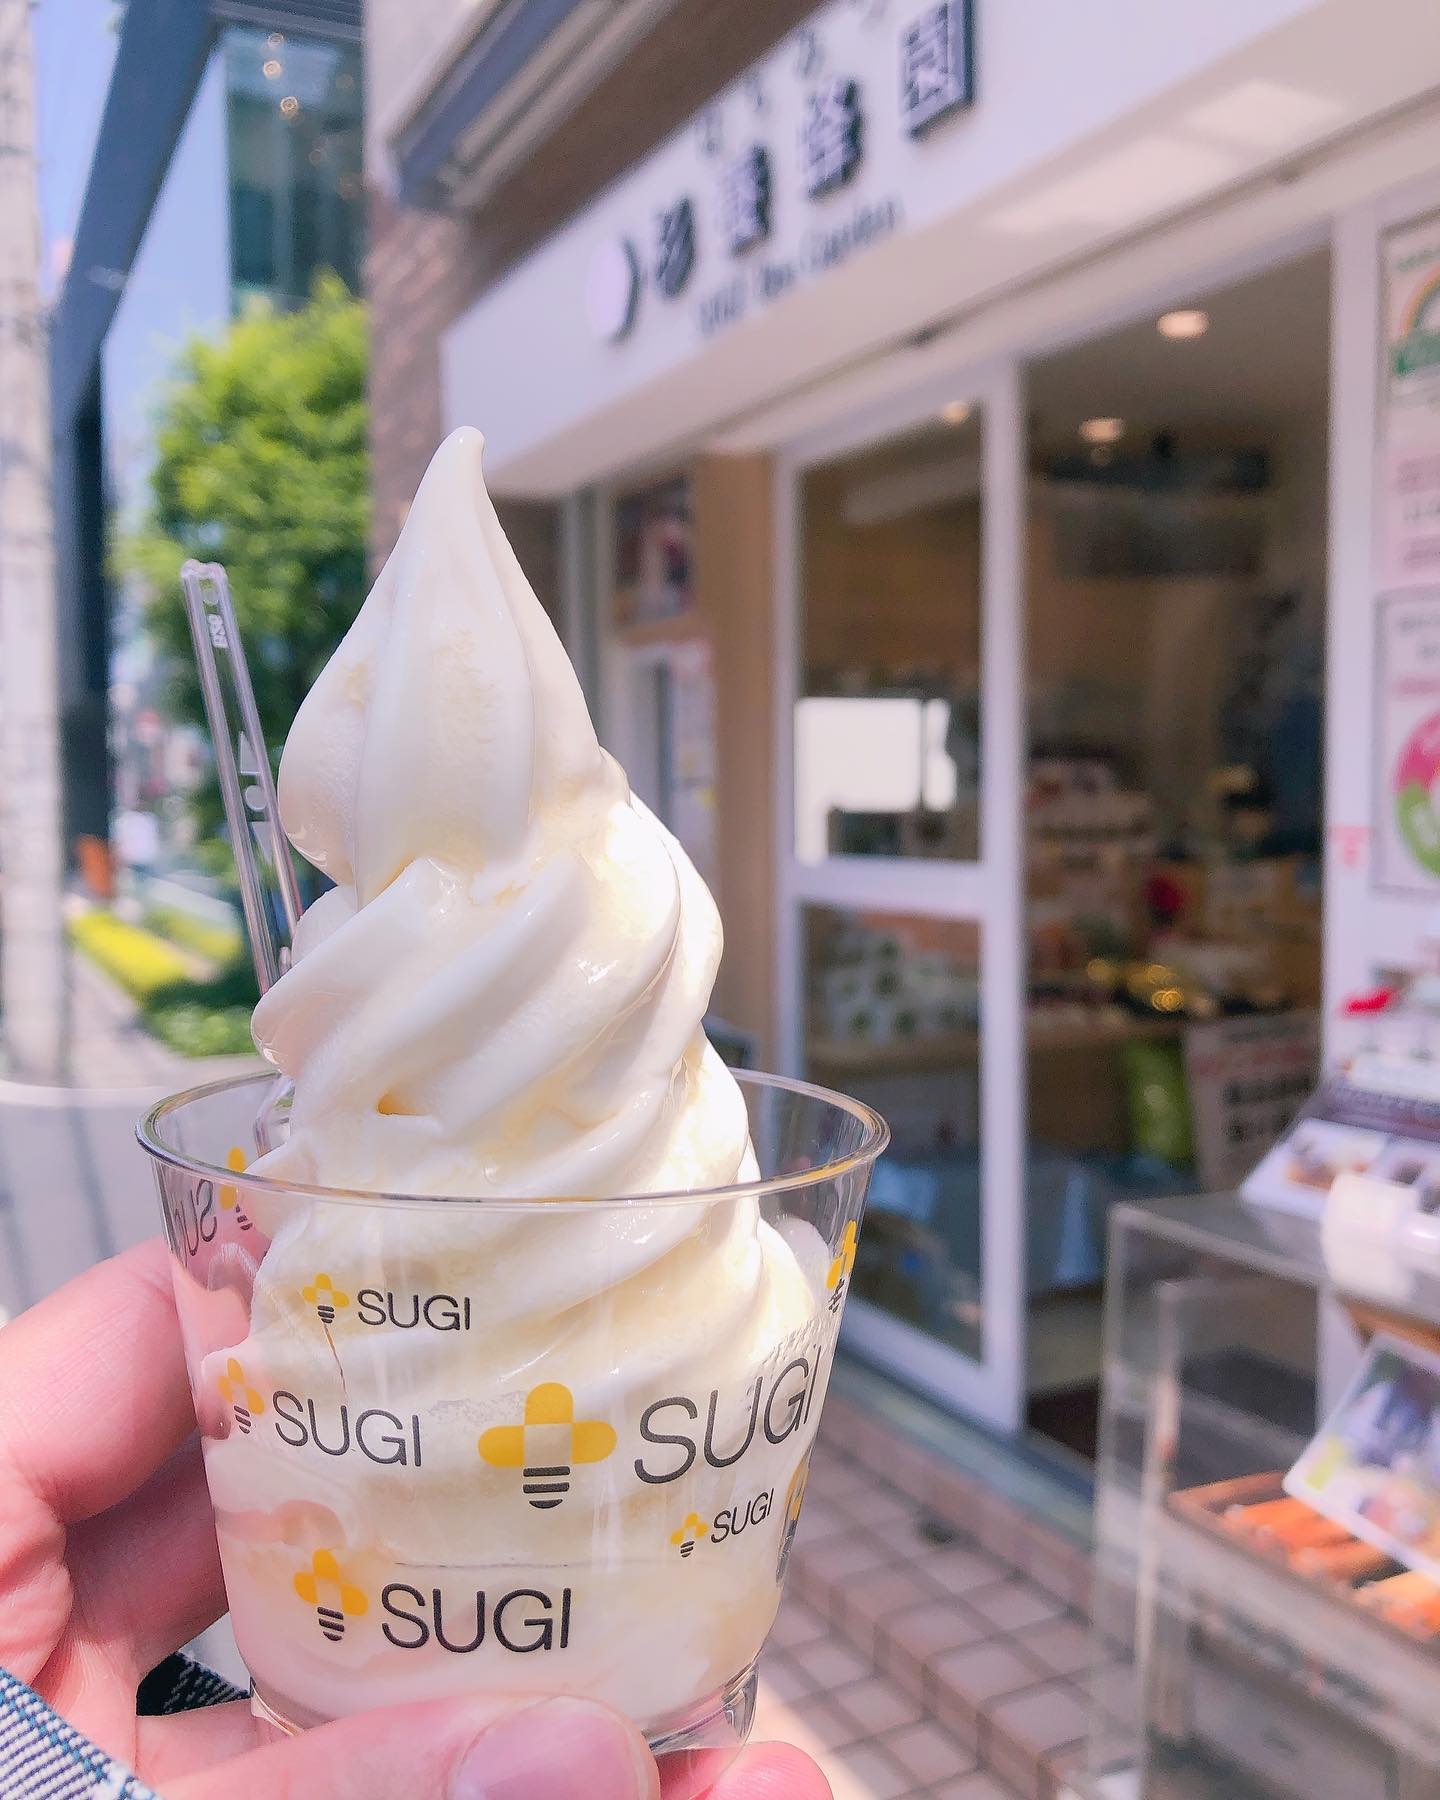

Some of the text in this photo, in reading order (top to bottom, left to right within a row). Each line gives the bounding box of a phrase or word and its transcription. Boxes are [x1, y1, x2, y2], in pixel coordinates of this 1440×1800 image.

[357, 1289, 470, 1331] SUGI
[272, 1390, 422, 1467] SUGI
[634, 1345, 821, 1484] SUGI
[710, 1487, 775, 1543] SUGI
[381, 1583, 571, 1653] SUGI
